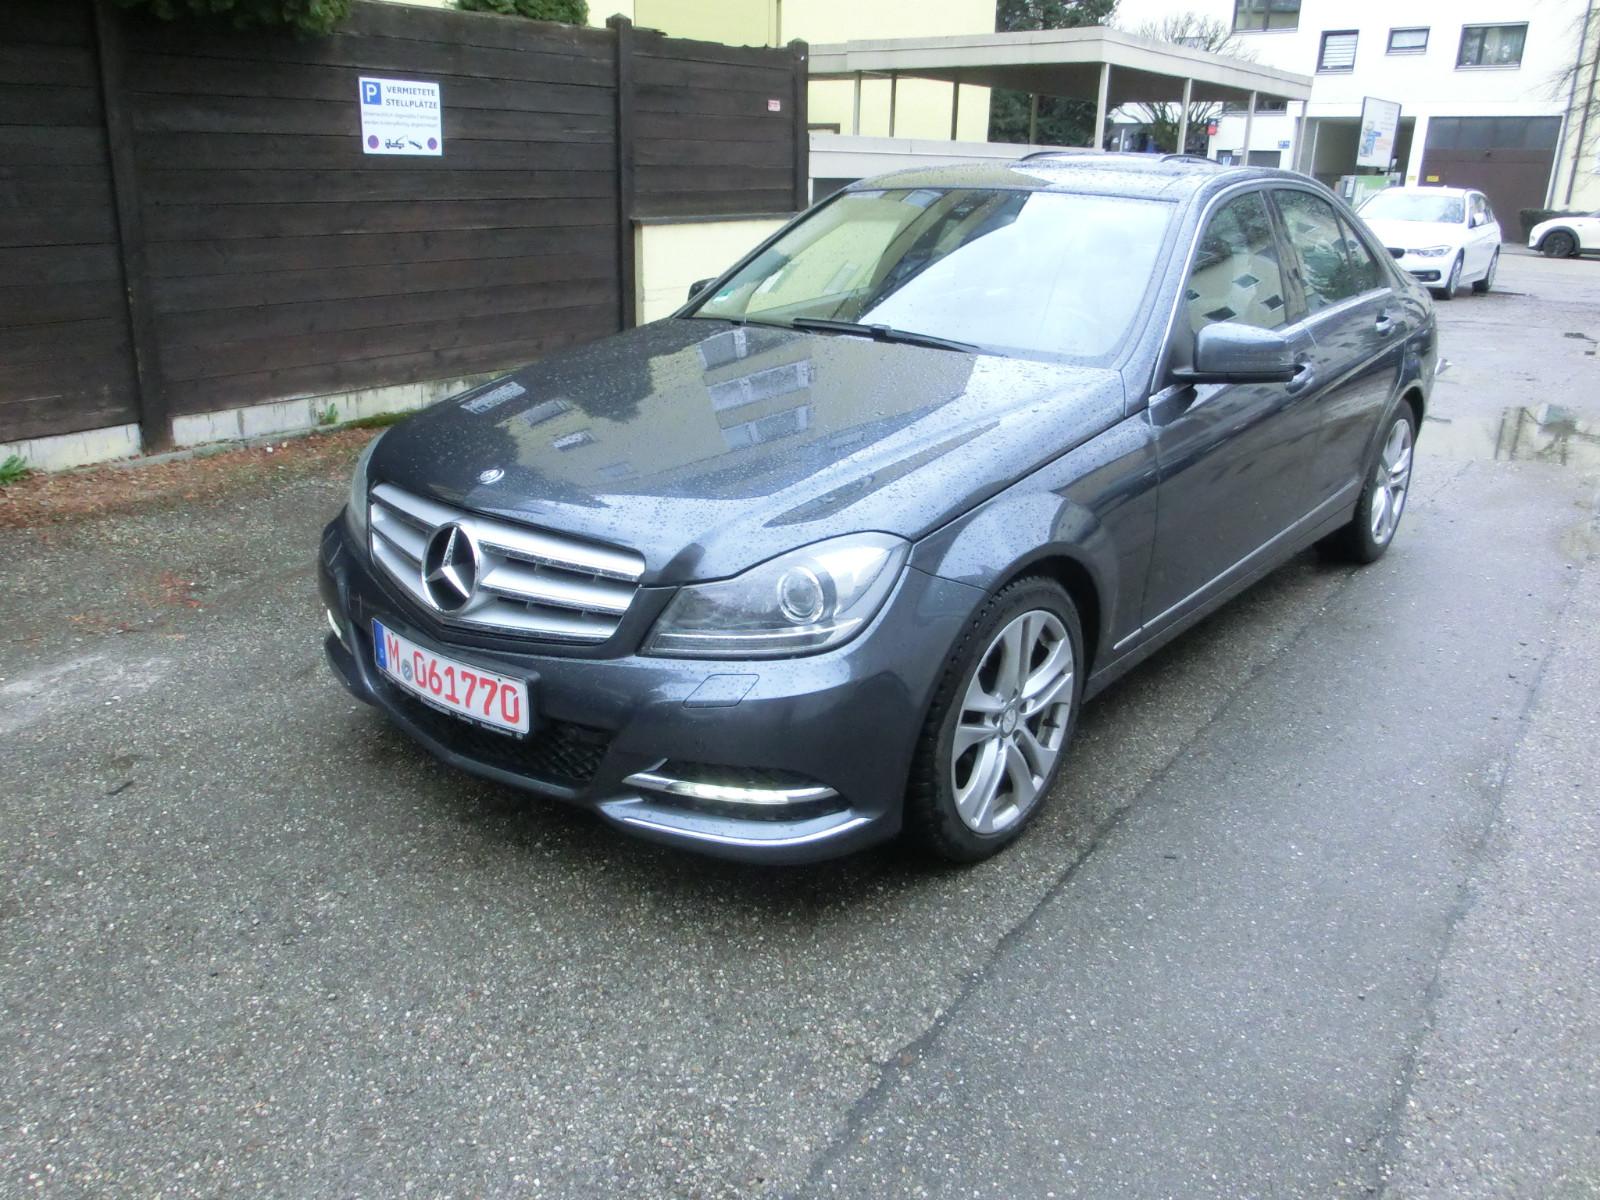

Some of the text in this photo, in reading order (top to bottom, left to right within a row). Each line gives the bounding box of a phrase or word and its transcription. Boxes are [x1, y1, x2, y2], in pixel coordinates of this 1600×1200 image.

[366, 84, 377, 102] P
[386, 86, 436, 97] VERMIETETE
[387, 633, 400, 673] M
[413, 651, 520, 724] 061770
